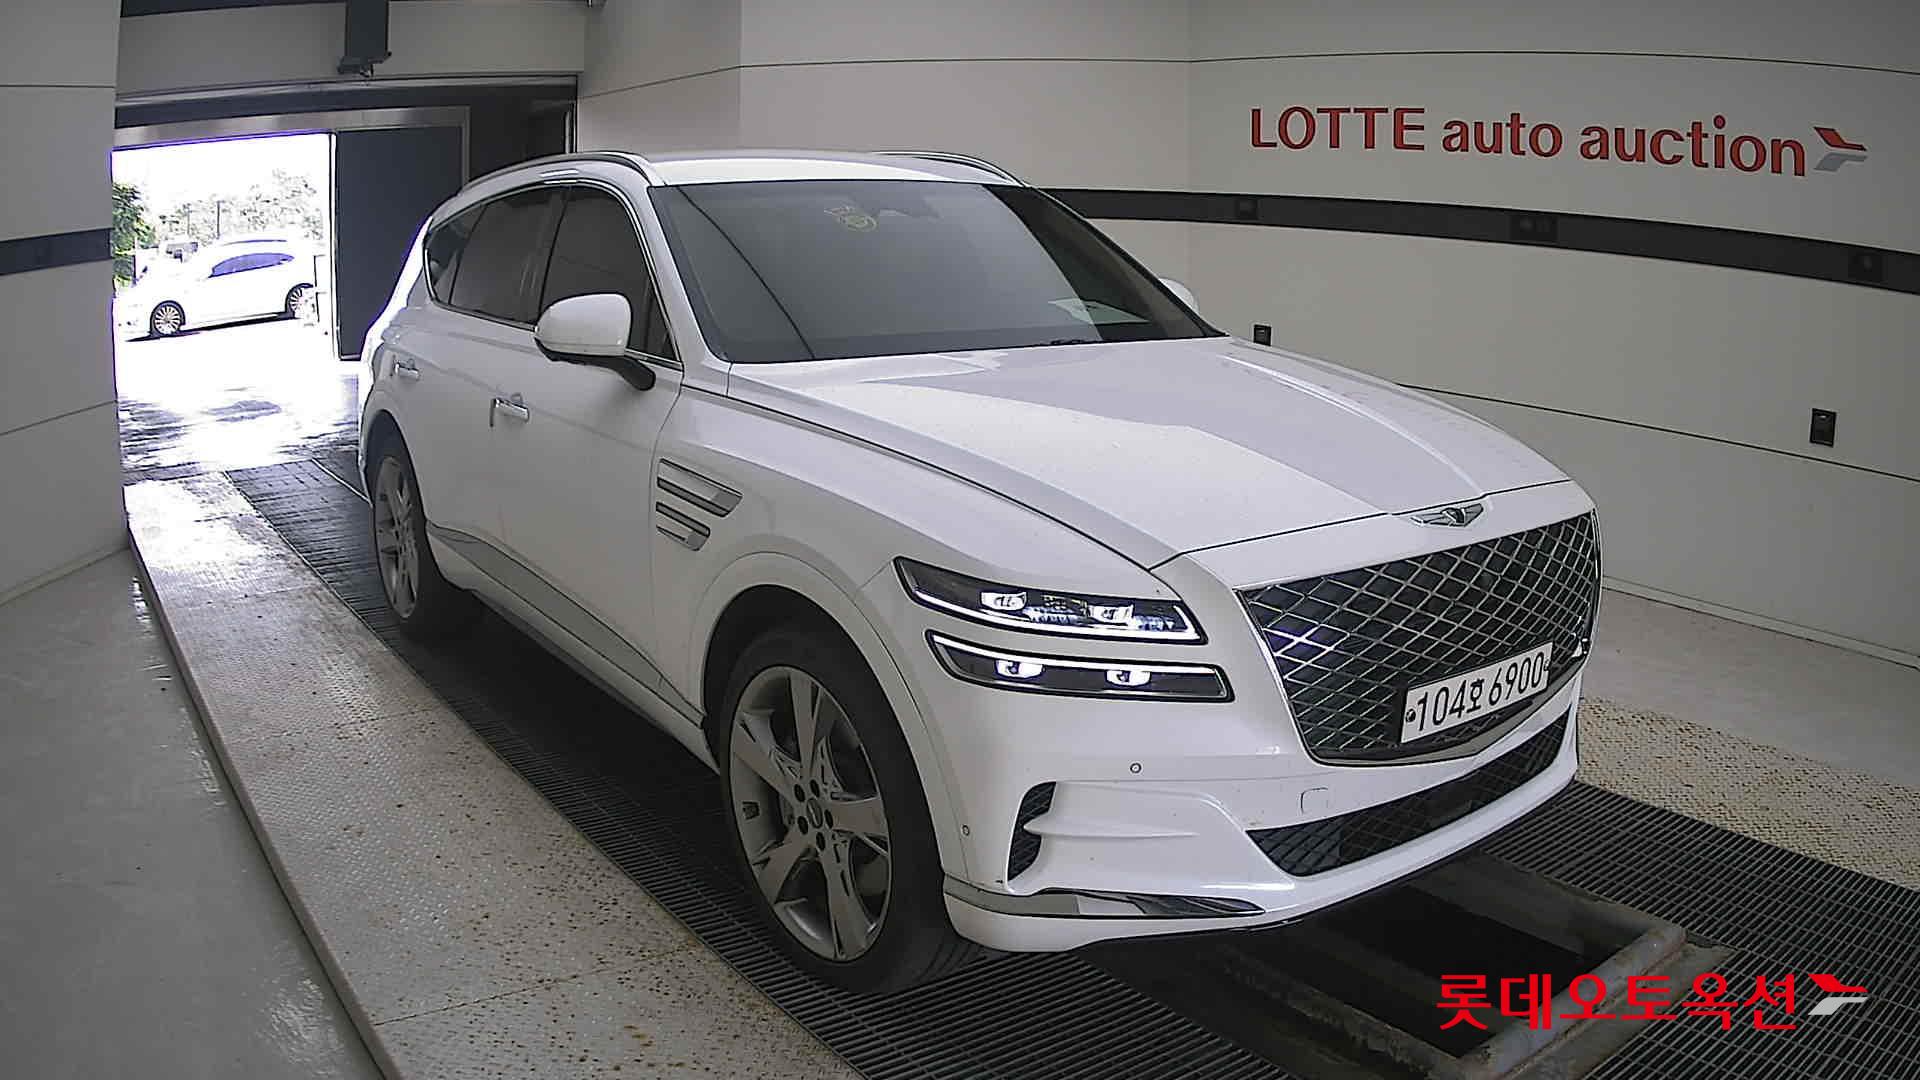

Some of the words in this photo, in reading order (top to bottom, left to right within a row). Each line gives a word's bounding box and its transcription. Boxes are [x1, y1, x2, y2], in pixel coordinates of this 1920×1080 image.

[1250, 105, 1425, 151] LOTTE
[1442, 113, 1563, 158] auto
[1579, 115, 1806, 177] auction
[1417, 678, 1485, 732] 104호
[1488, 651, 1545, 707] 6900
